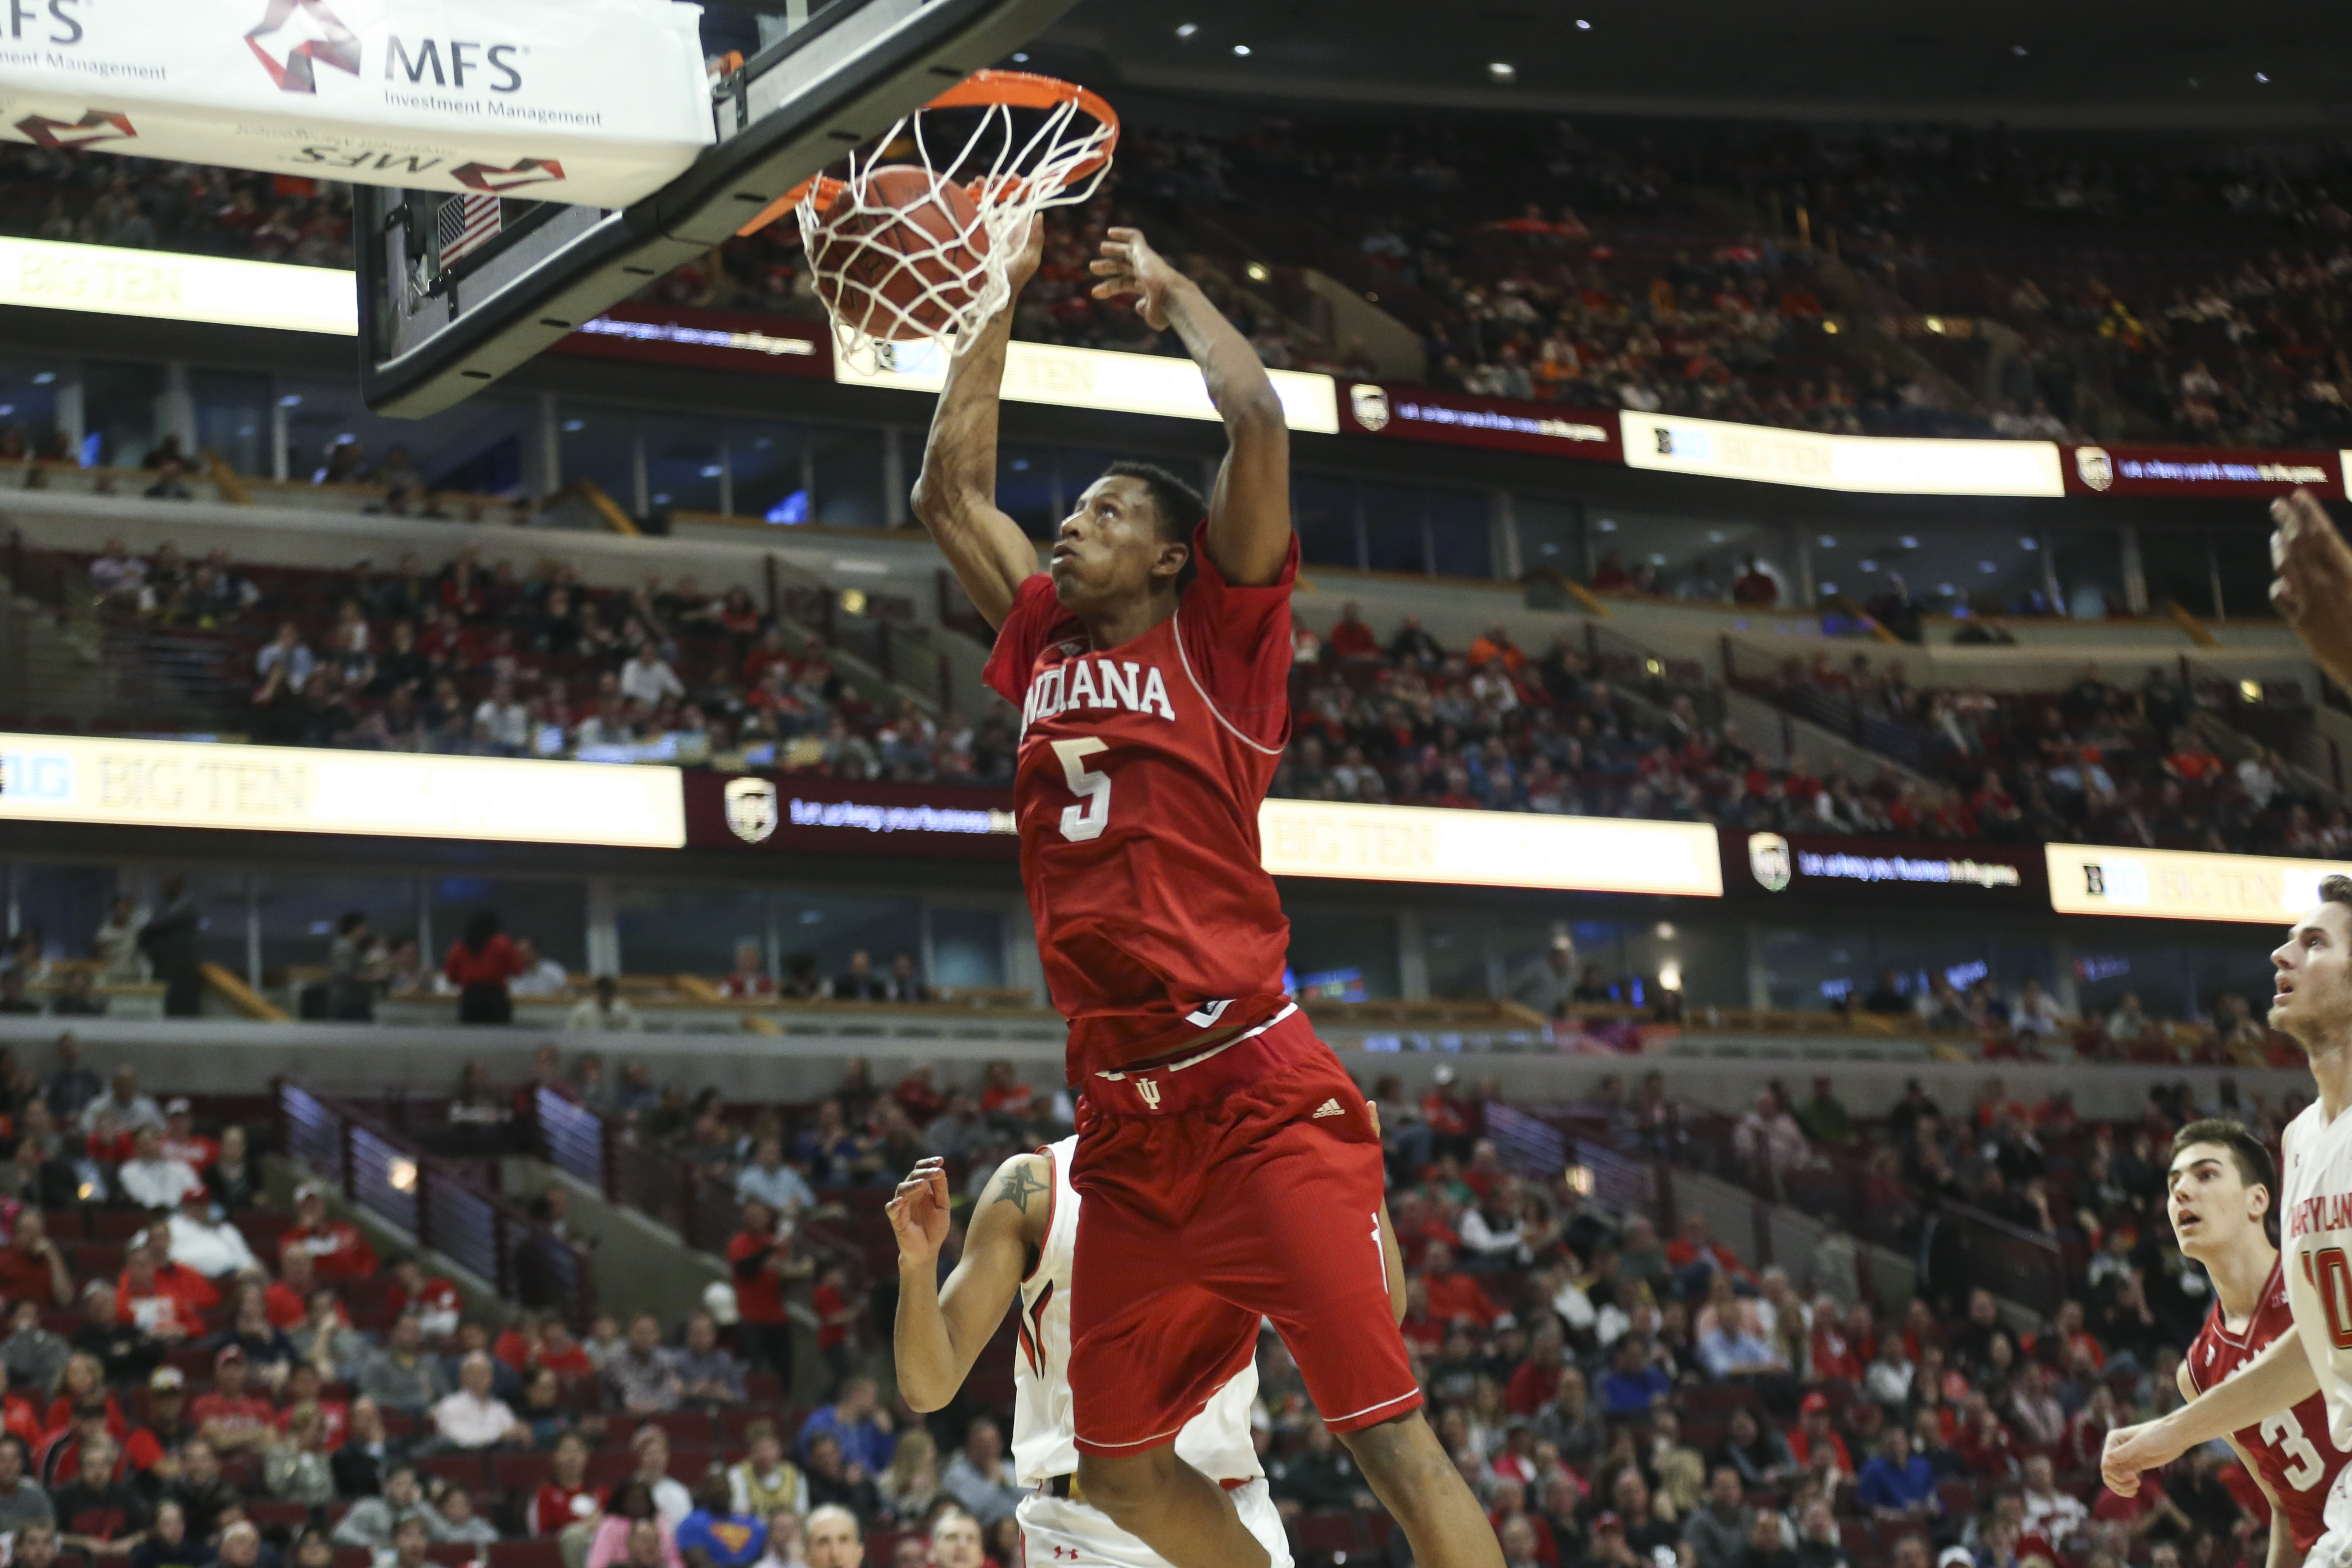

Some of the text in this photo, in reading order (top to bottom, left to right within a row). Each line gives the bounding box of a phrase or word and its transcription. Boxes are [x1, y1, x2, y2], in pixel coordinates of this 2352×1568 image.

[0, 0, 83, 44] FS
[47, 52, 167, 81] Management
[385, 89, 602, 127] Investment Management
[1020, 659, 1175, 745] NDIANA
[99, 752, 184, 810] BIG
[195, 759, 307, 815] TEN
[1050, 736, 1111, 842] 5
